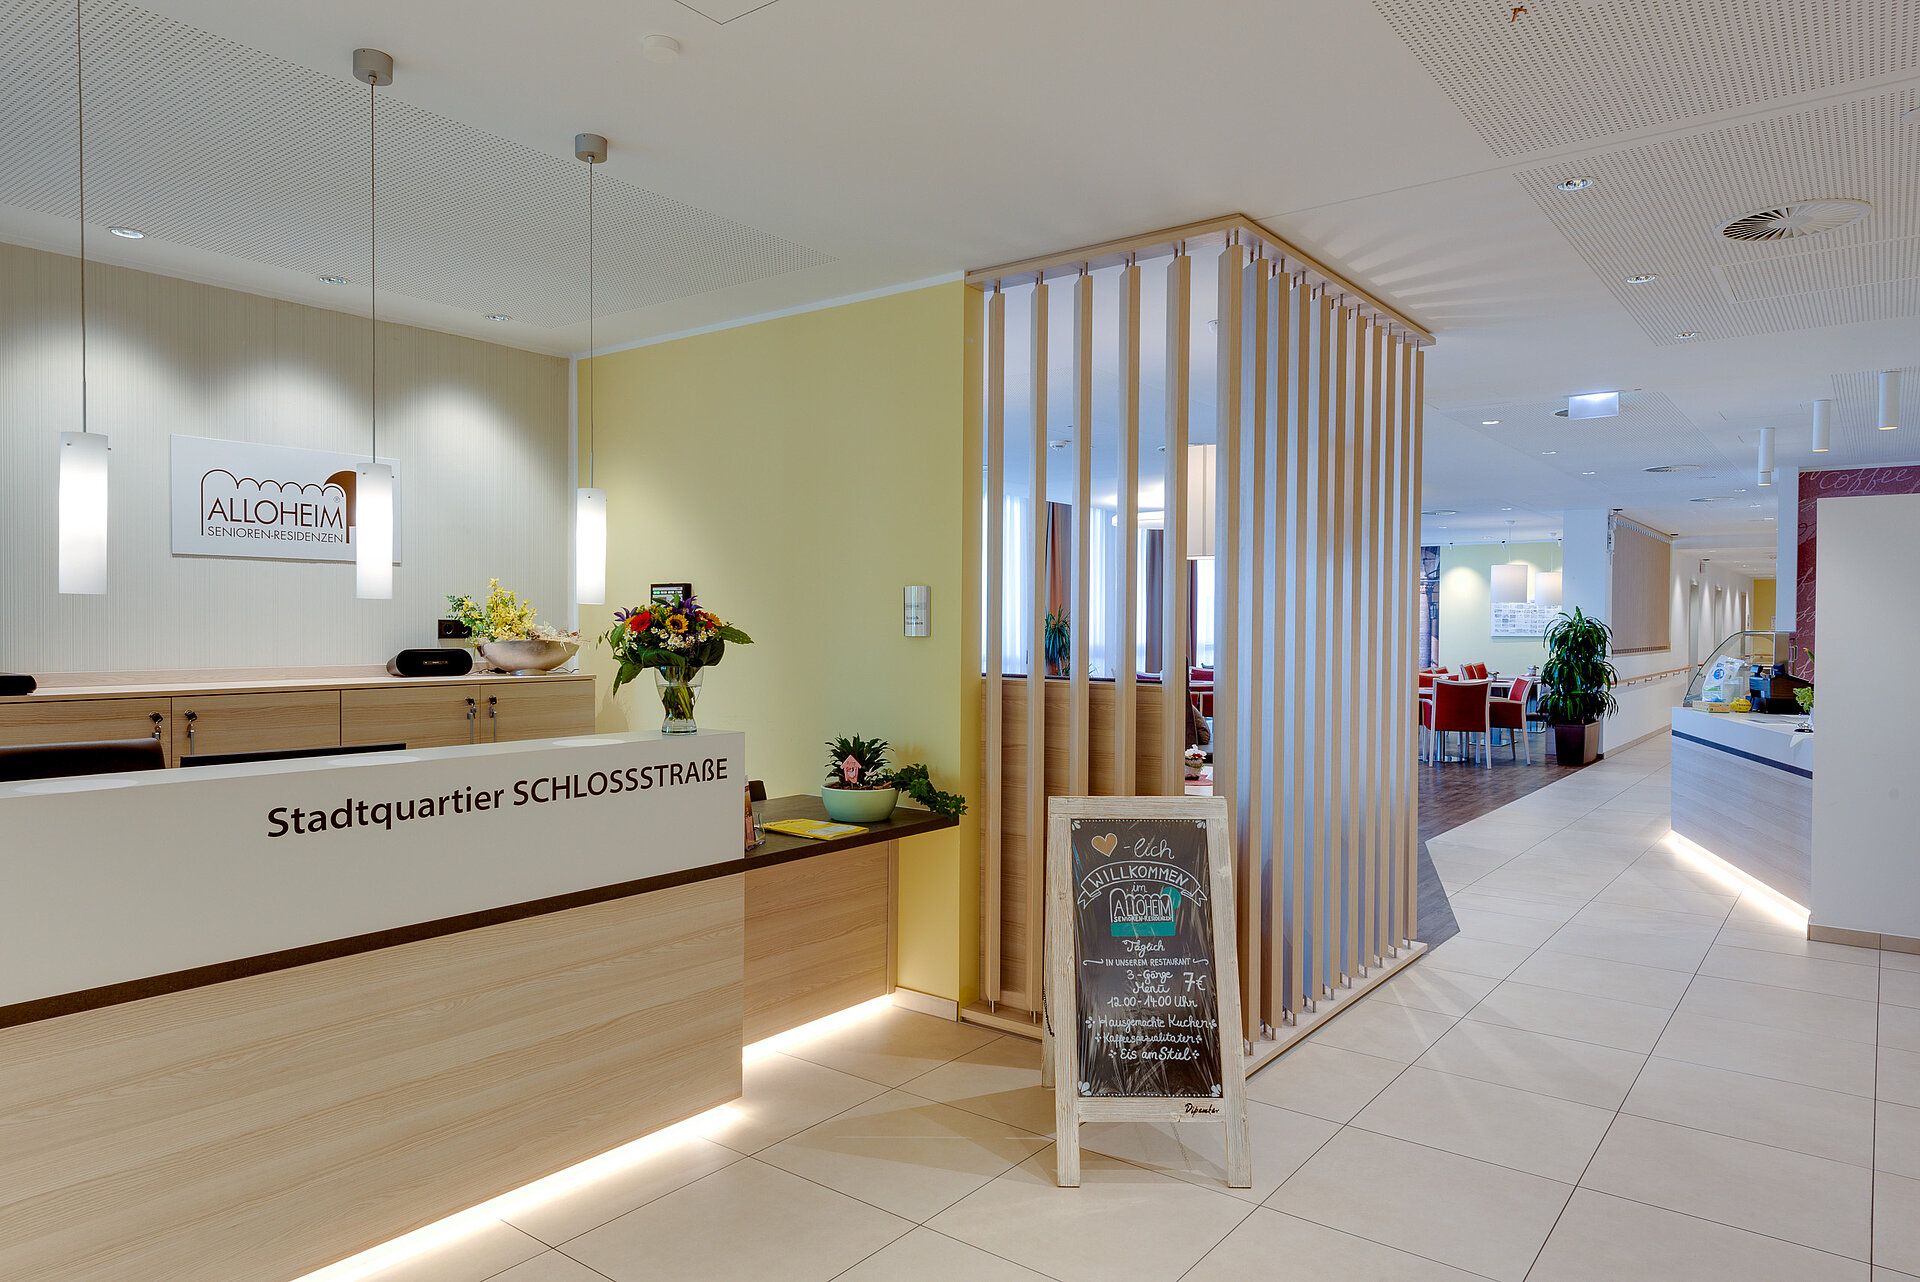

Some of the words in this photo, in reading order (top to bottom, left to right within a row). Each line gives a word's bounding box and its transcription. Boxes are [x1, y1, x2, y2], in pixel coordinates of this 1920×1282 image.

[207, 497, 343, 529] ALLOHEIM
[207, 526, 343, 543] SENIOREN-RESIDENZEN
[267, 785, 504, 838] Stadtquartier
[512, 758, 728, 806] SCHLOSSSTRAßE
[1087, 865, 1190, 888] WILLKOMMEN
[1131, 882, 1148, 893] im
[1113, 899, 1172, 917] ALLOHEIM
[1122, 940, 1165, 958] Täglich
[1105, 958, 1114, 967] IN
[1115, 958, 1148, 967] UNSEREM
[1149, 957, 1191, 967] RESTAURANT
[1132, 981, 1170, 994] Menü
[1183, 971, 1207, 993] 7€
[1174, 995, 1198, 1008] Uhr
[1098, 1014, 1165, 1033] Hausgemachte
[1168, 1014, 1209, 1029] Kuchen
[1120, 1048, 1137, 1060] Eis
[1141, 1050, 1159, 1060] am
[1160, 1046, 1191, 1061] Stiel
